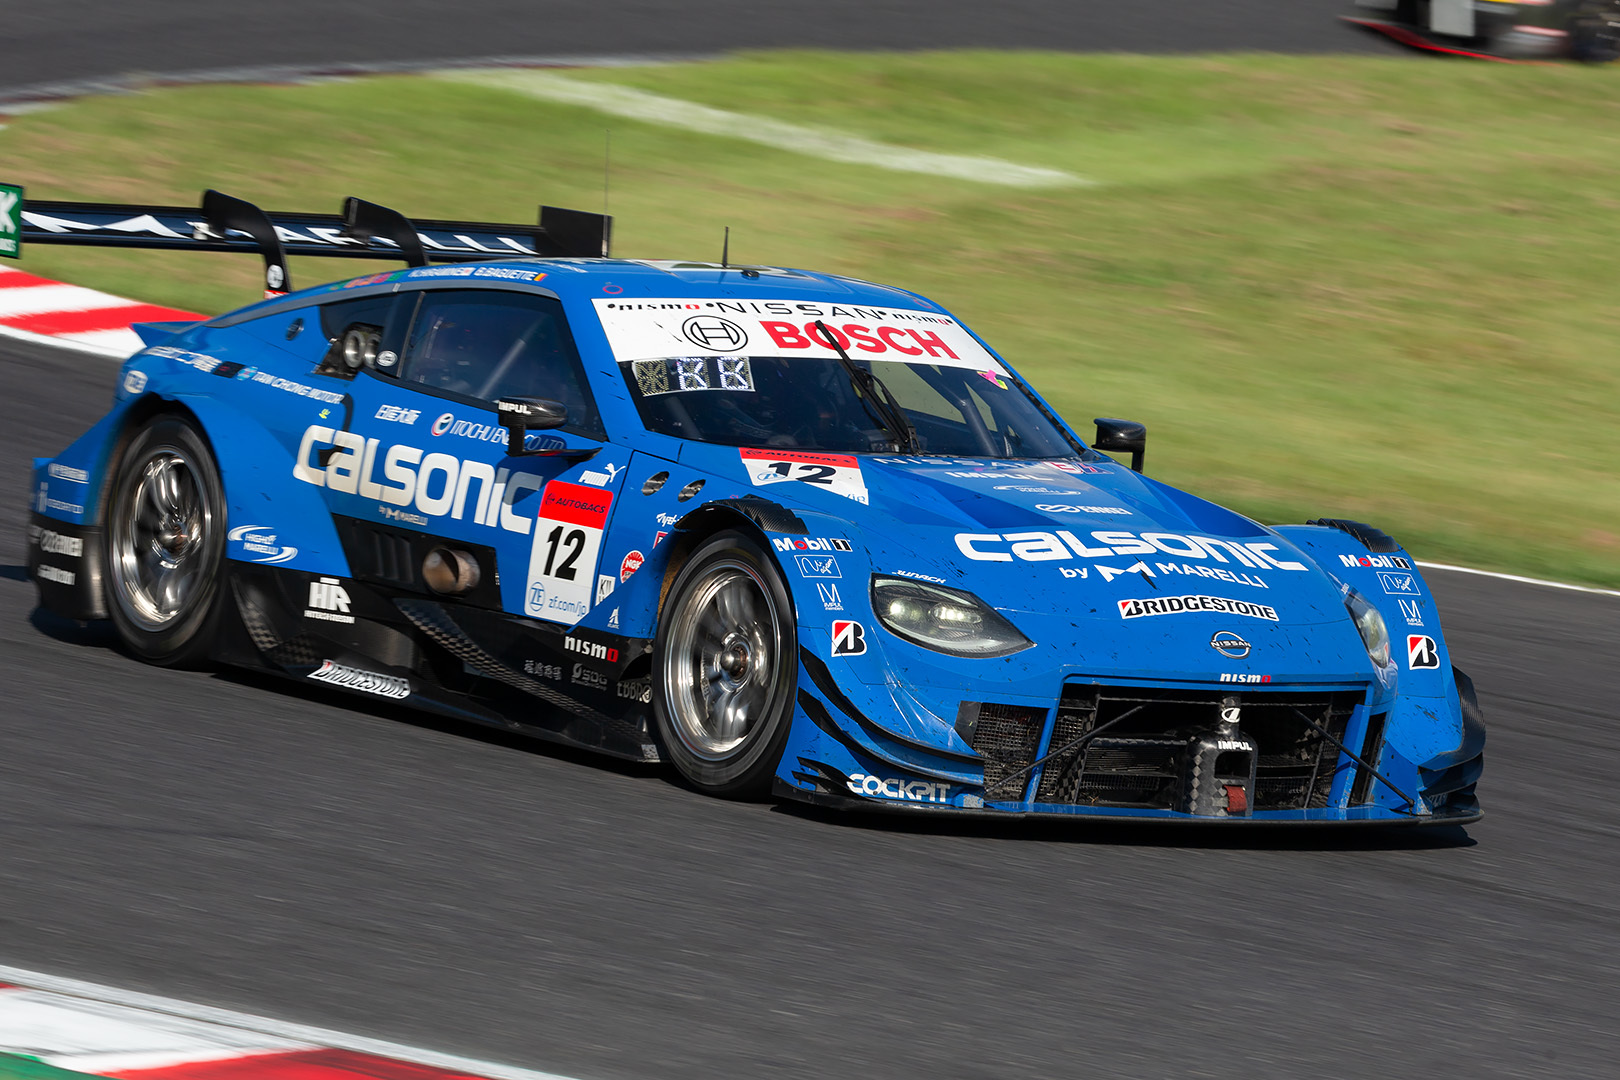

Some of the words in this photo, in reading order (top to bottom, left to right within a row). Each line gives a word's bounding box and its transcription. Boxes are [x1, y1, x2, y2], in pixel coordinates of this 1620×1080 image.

[716, 302, 883, 320] NISSAN
[759, 320, 961, 360] BOSCH
[578, 470, 611, 487] PUMA
[768, 462, 837, 485] 12
[555, 497, 606, 514] AUTOBACS
[543, 525, 586, 581] 12
[772, 537, 832, 552] Mobil
[1338, 554, 1394, 568] Mobil
[1059, 567, 1088, 578] by
[1155, 562, 1269, 588] MARELLI
[548, 596, 587, 616] zf.com/jp
[1121, 596, 1277, 619] BRIDGESTONE
[564, 636, 619, 662] nismo
[1211, 640, 1251, 648] NISSAN
[1220, 673, 1271, 683] nismo
[1218, 740, 1252, 751] IMPUL
[846, 773, 951, 803] COCKPIT
